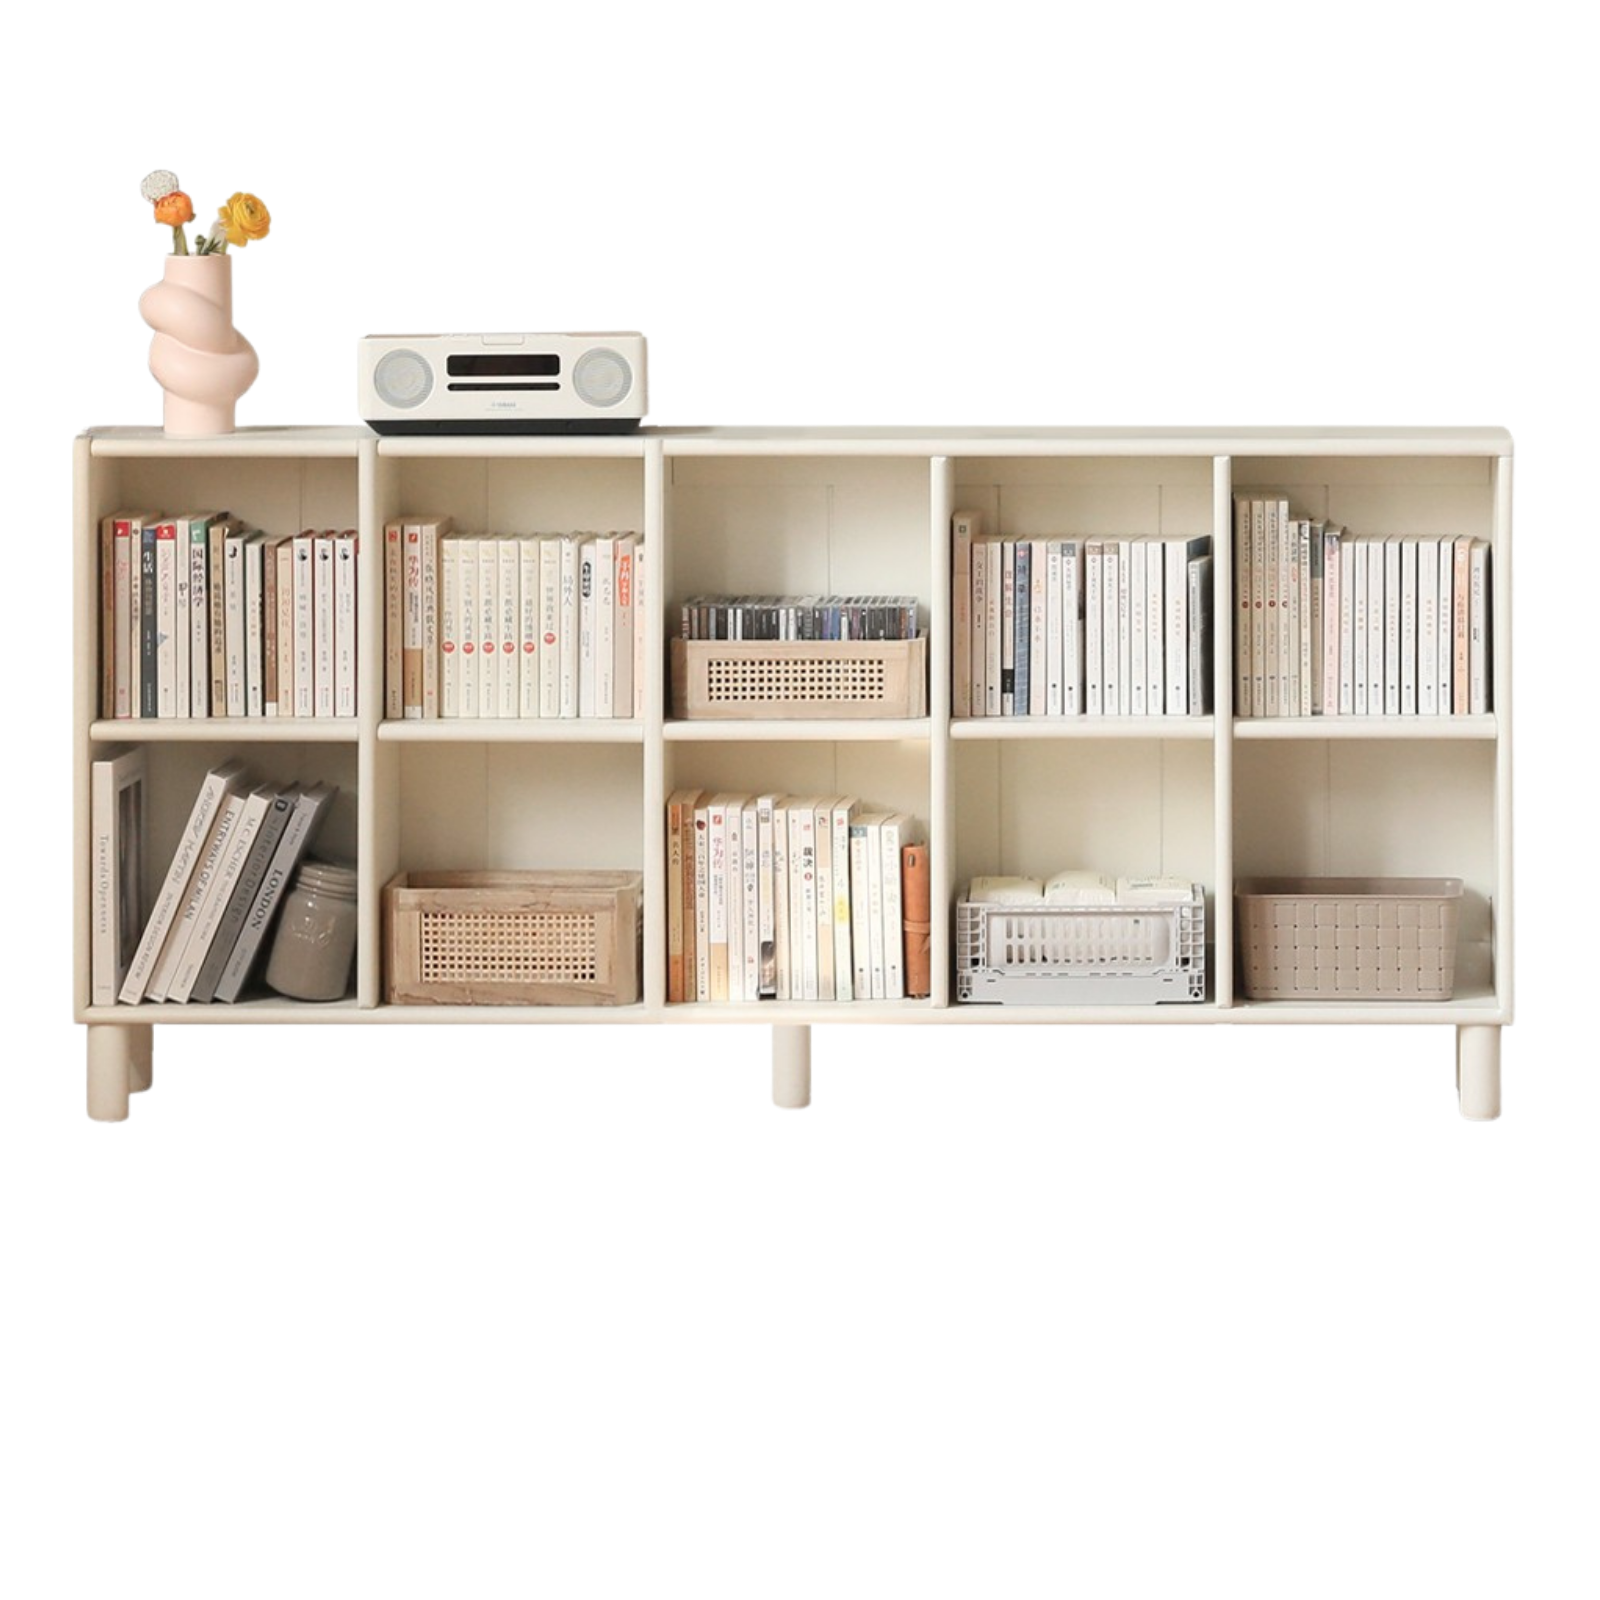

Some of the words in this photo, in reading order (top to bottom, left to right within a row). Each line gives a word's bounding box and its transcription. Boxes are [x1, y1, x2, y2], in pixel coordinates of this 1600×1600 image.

[192, 549, 204, 607] 国际经济学
[408, 555, 419, 587] 华为传
[563, 575, 574, 606] 局外人
[100, 834, 109, 878] Towards
[205, 811, 235, 872] ENTRYWAYS
[226, 840, 246, 879] ESCHER
[252, 826, 278, 877] Interior
[803, 847, 813, 867] 裁决
[198, 871, 210, 887] OF
[251, 869, 283, 930] LONDON
[99, 881, 109, 934] Openness
[185, 887, 204, 920] MILAN
[229, 878, 255, 925] Design
